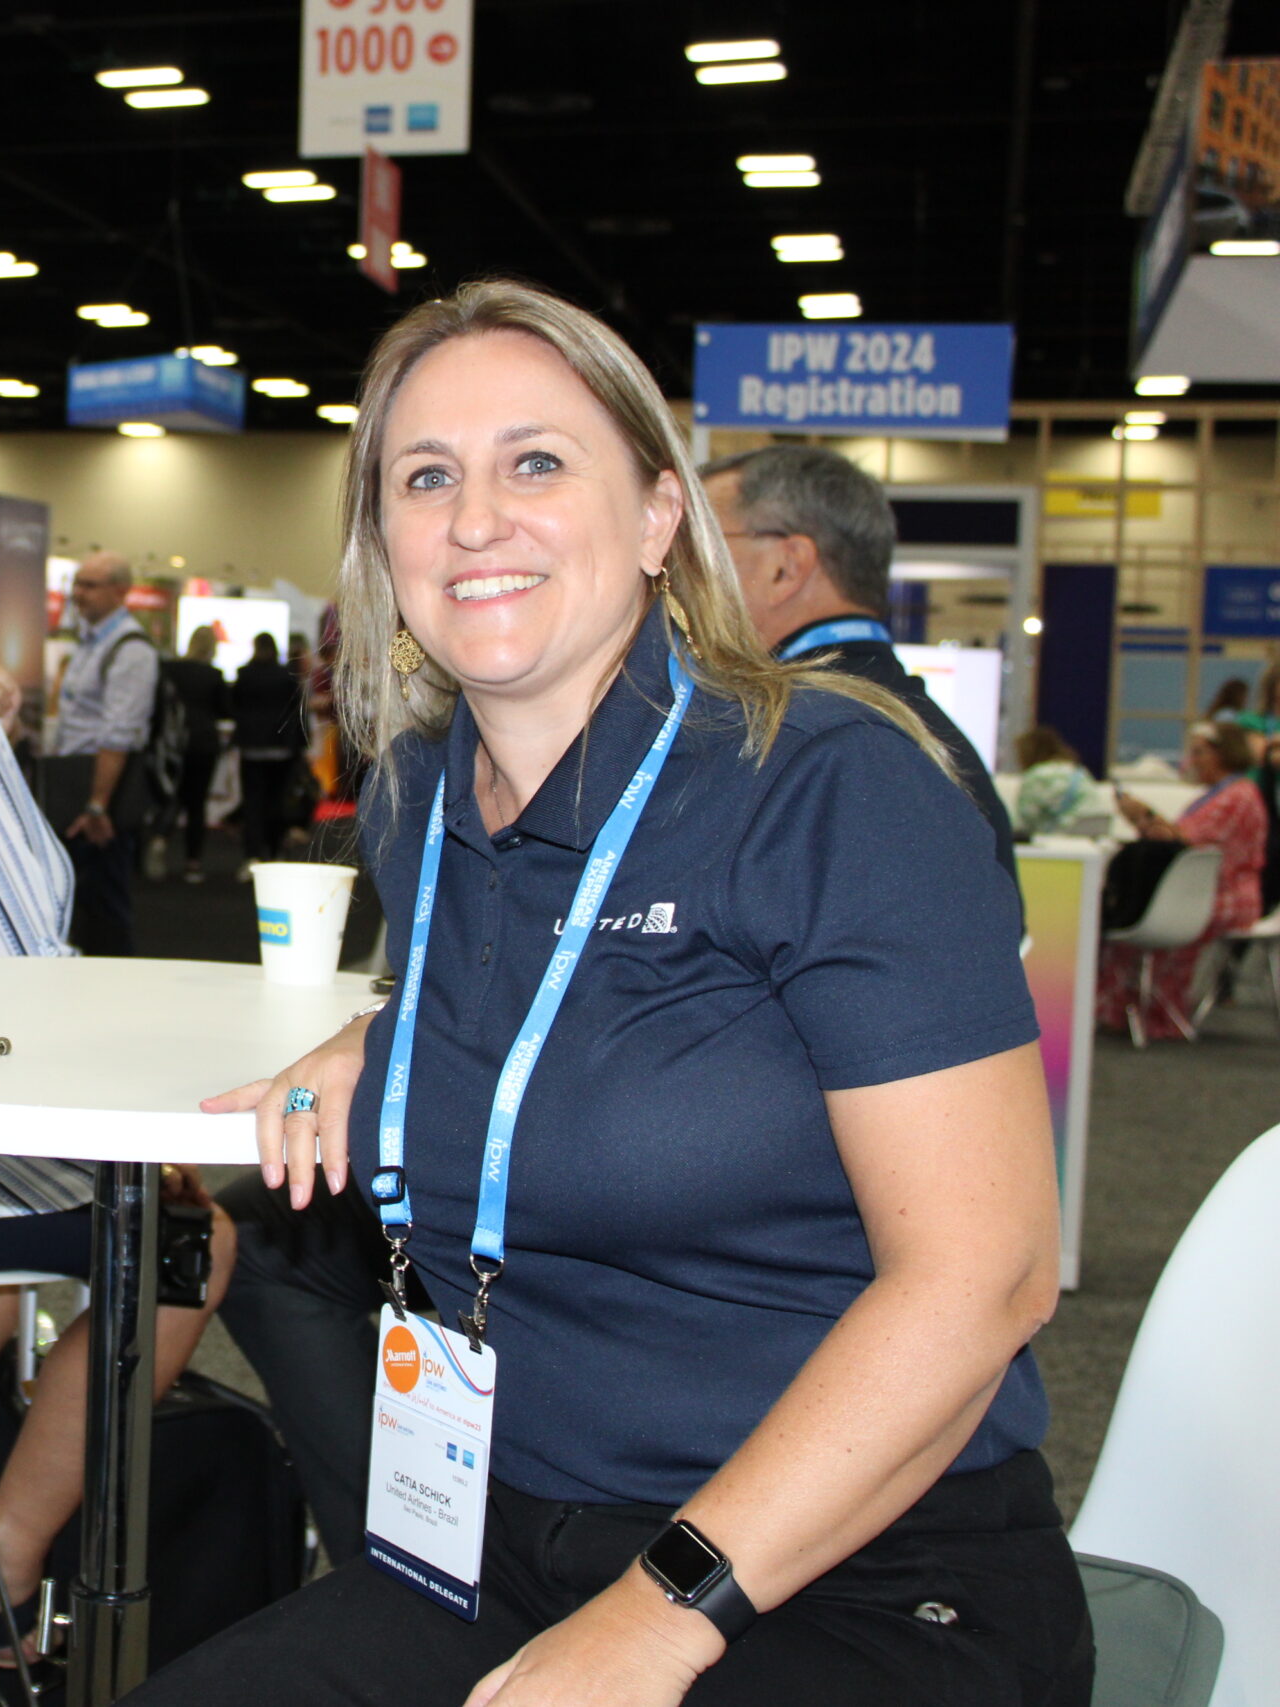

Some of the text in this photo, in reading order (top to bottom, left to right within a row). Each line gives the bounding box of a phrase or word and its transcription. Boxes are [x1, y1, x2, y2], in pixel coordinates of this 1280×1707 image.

[316, 23, 415, 77] 1000
[768, 332, 936, 373] IPW 2024
[739, 375, 962, 422] Registration
[652, 683, 687, 751] AMERICAN
[571, 858, 602, 927] EXPRESS
[579, 850, 616, 928] AMERICAN
[553, 913, 644, 936] UTED
[548, 950, 577, 990] ipw
[387, 1063, 405, 1103] ipw
[506, 1032, 542, 1114] AMERICAN
[488, 1138, 508, 1183] ipw
[421, 1351, 445, 1378] ipw
[378, 1405, 398, 1430] ipw
[386, 1480, 406, 1501] United
[408, 1494, 432, 1514] Airlines
[438, 1507, 459, 1527] Brazil
[393, 1471, 451, 1508] CATIA SCHICK
[370, 1547, 468, 1610] INTERNATIONAL DELEGATE
